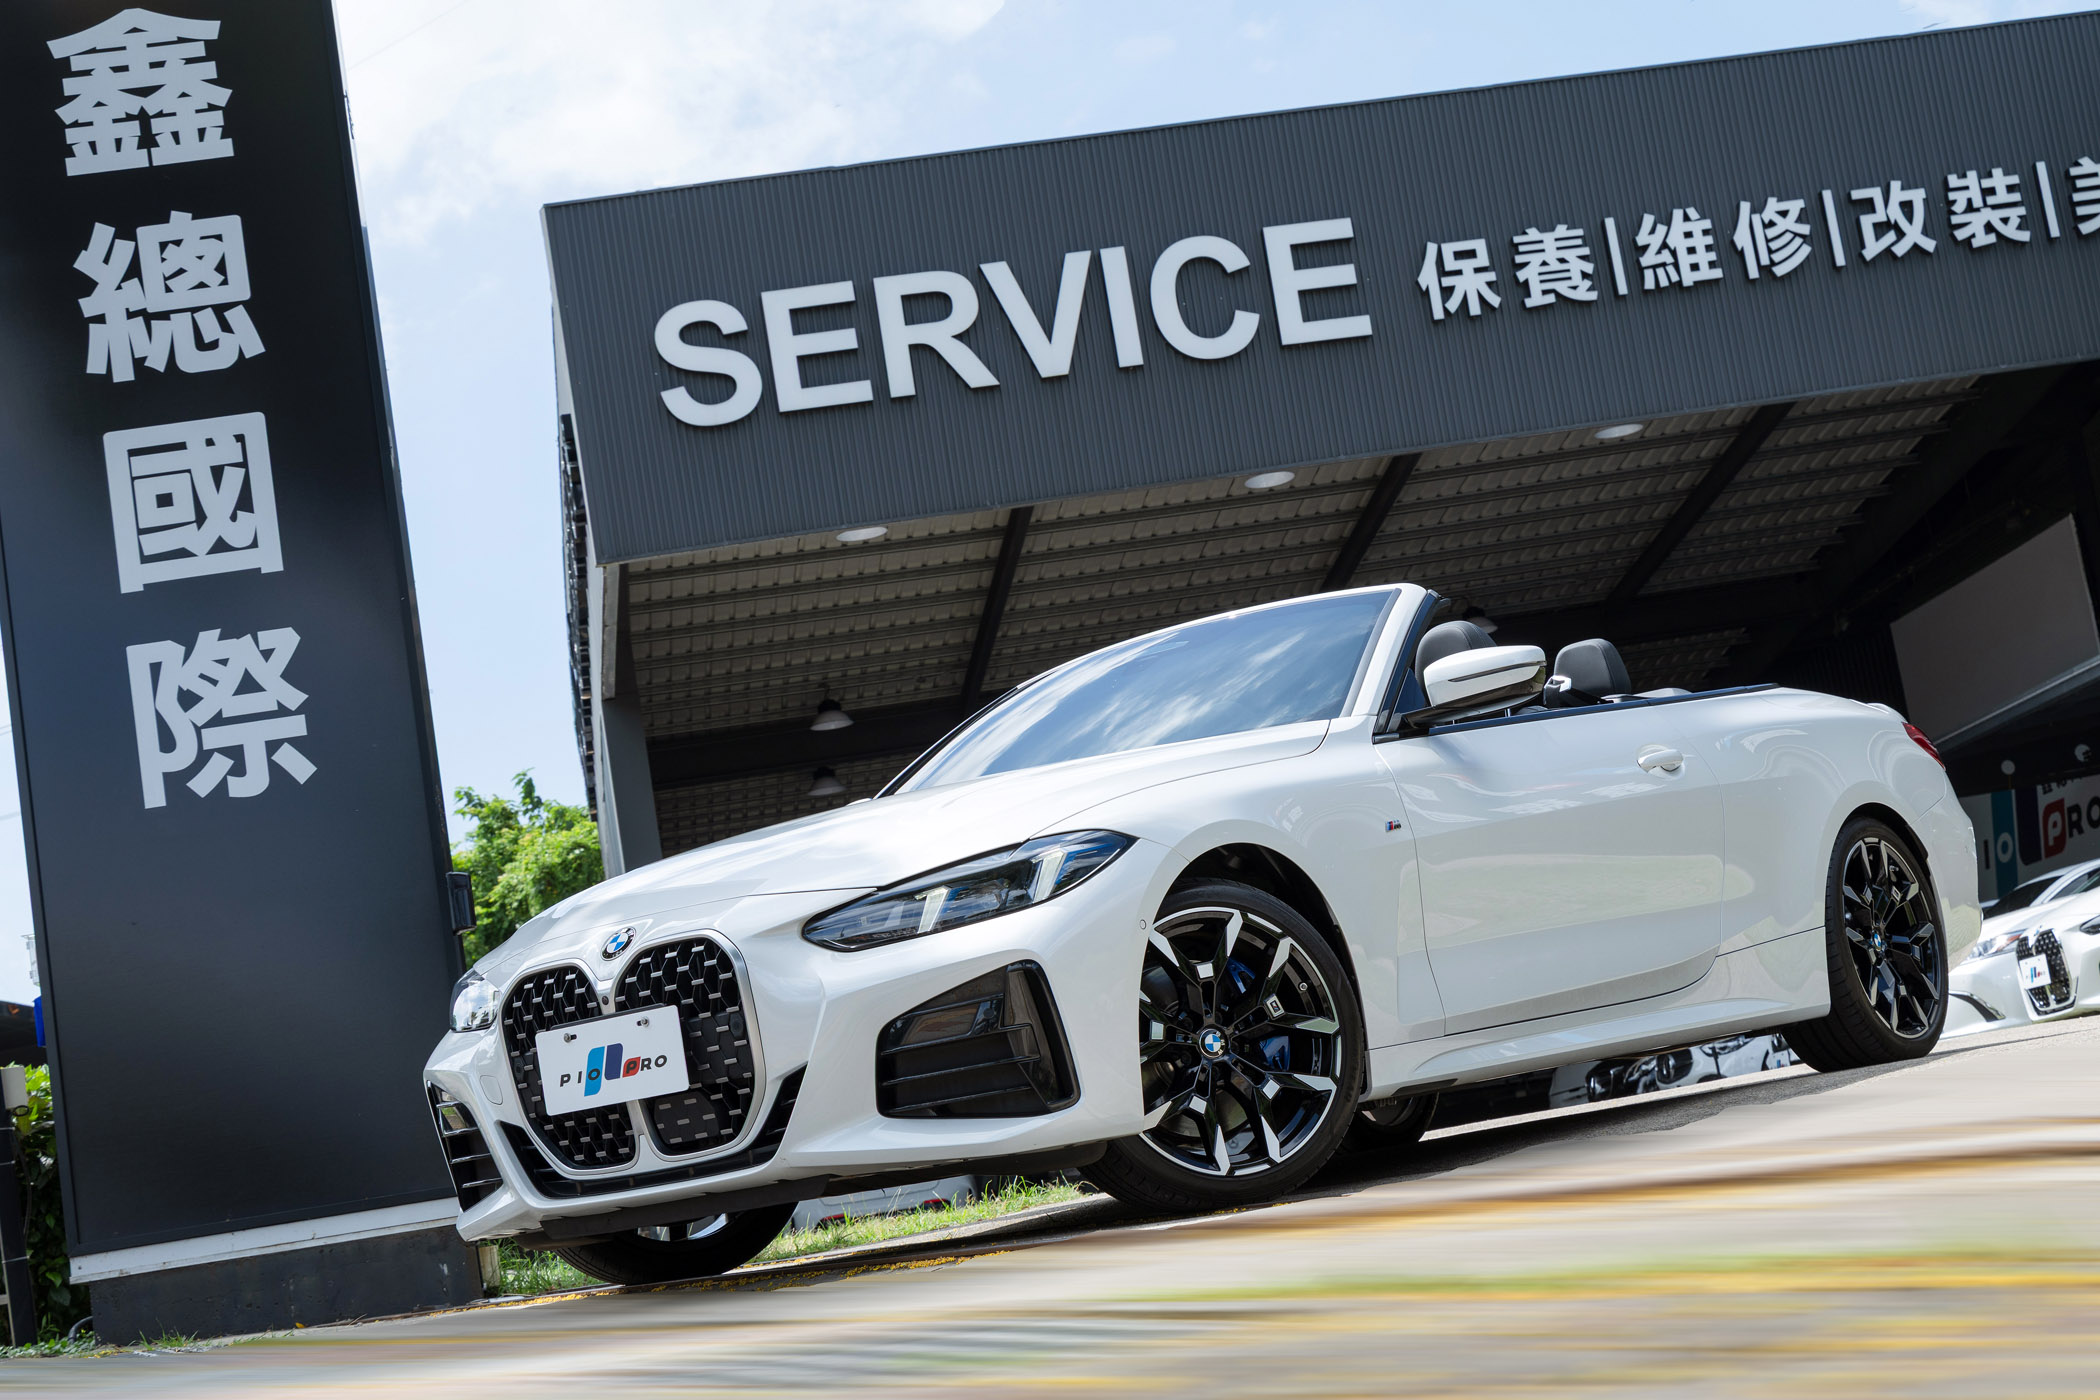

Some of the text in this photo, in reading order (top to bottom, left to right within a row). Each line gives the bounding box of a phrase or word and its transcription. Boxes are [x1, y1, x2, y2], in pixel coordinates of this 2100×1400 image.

[47, 8, 317, 808] 鑫總國際
[654, 217, 1373, 426] SERVICE
